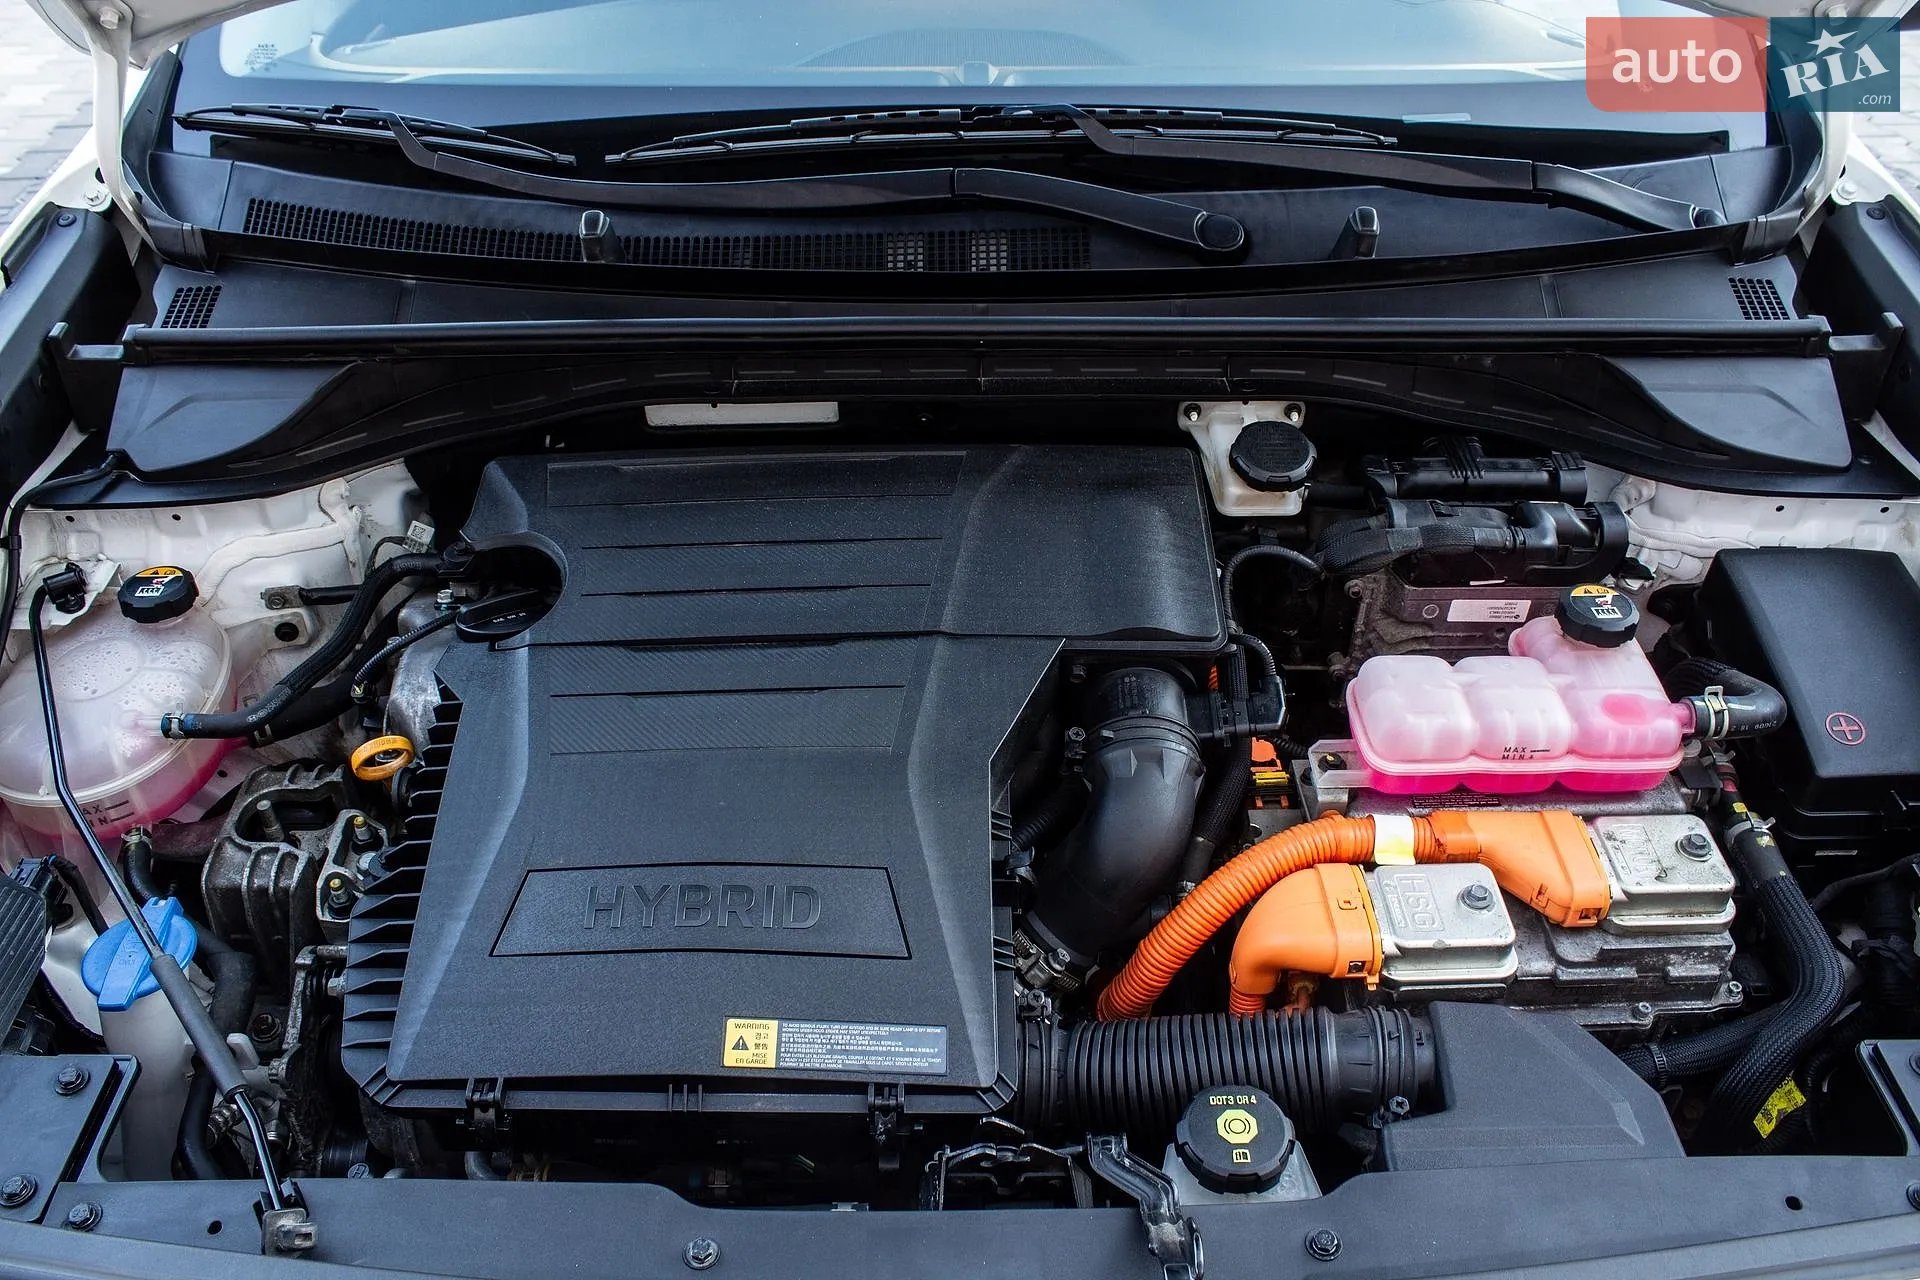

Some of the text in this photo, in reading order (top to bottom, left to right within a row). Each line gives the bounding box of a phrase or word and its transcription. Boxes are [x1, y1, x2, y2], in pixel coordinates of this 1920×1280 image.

[82, 804, 102, 815] AX
[584, 884, 822, 929] HYBRID
[734, 1022, 770, 1030] WARNING
[1209, 1094, 1257, 1105] DOT3 OR 4
